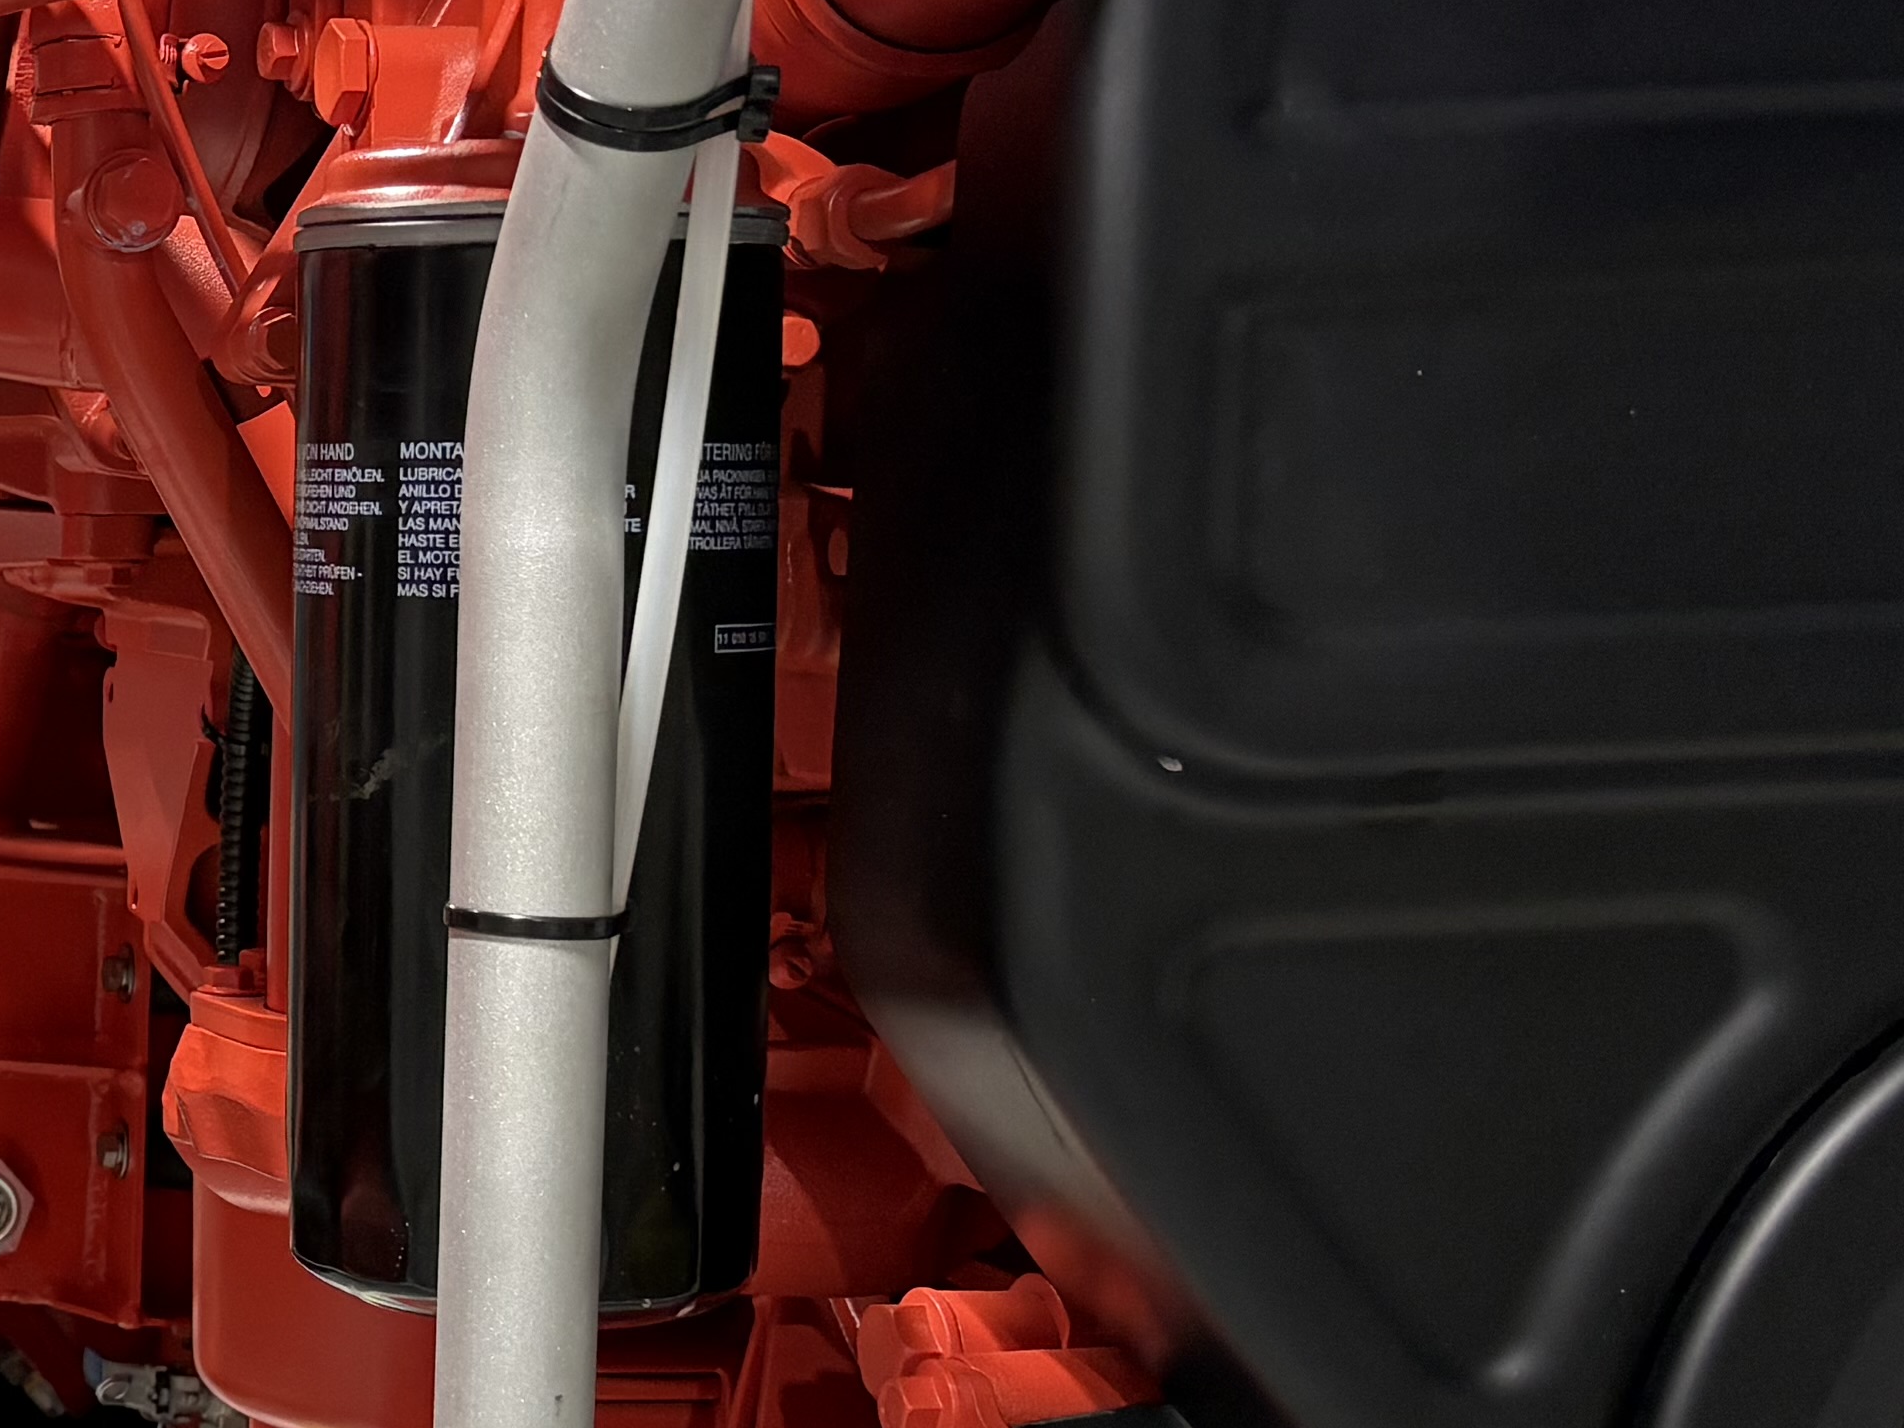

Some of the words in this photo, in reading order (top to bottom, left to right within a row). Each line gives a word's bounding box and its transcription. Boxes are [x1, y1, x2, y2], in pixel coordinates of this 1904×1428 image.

[320, 443, 354, 460] HAND
[334, 485, 356, 498] UND
[399, 484, 451, 498] ANILLO
[398, 501, 409, 514] Y
[398, 517, 425, 531] LAS
[398, 534, 444, 547] HASTE
[397, 550, 414, 564] EL
[397, 567, 410, 580] SI
[414, 567, 443, 580] HAY
[397, 583, 428, 597] MAS
[432, 584, 446, 597] SI
